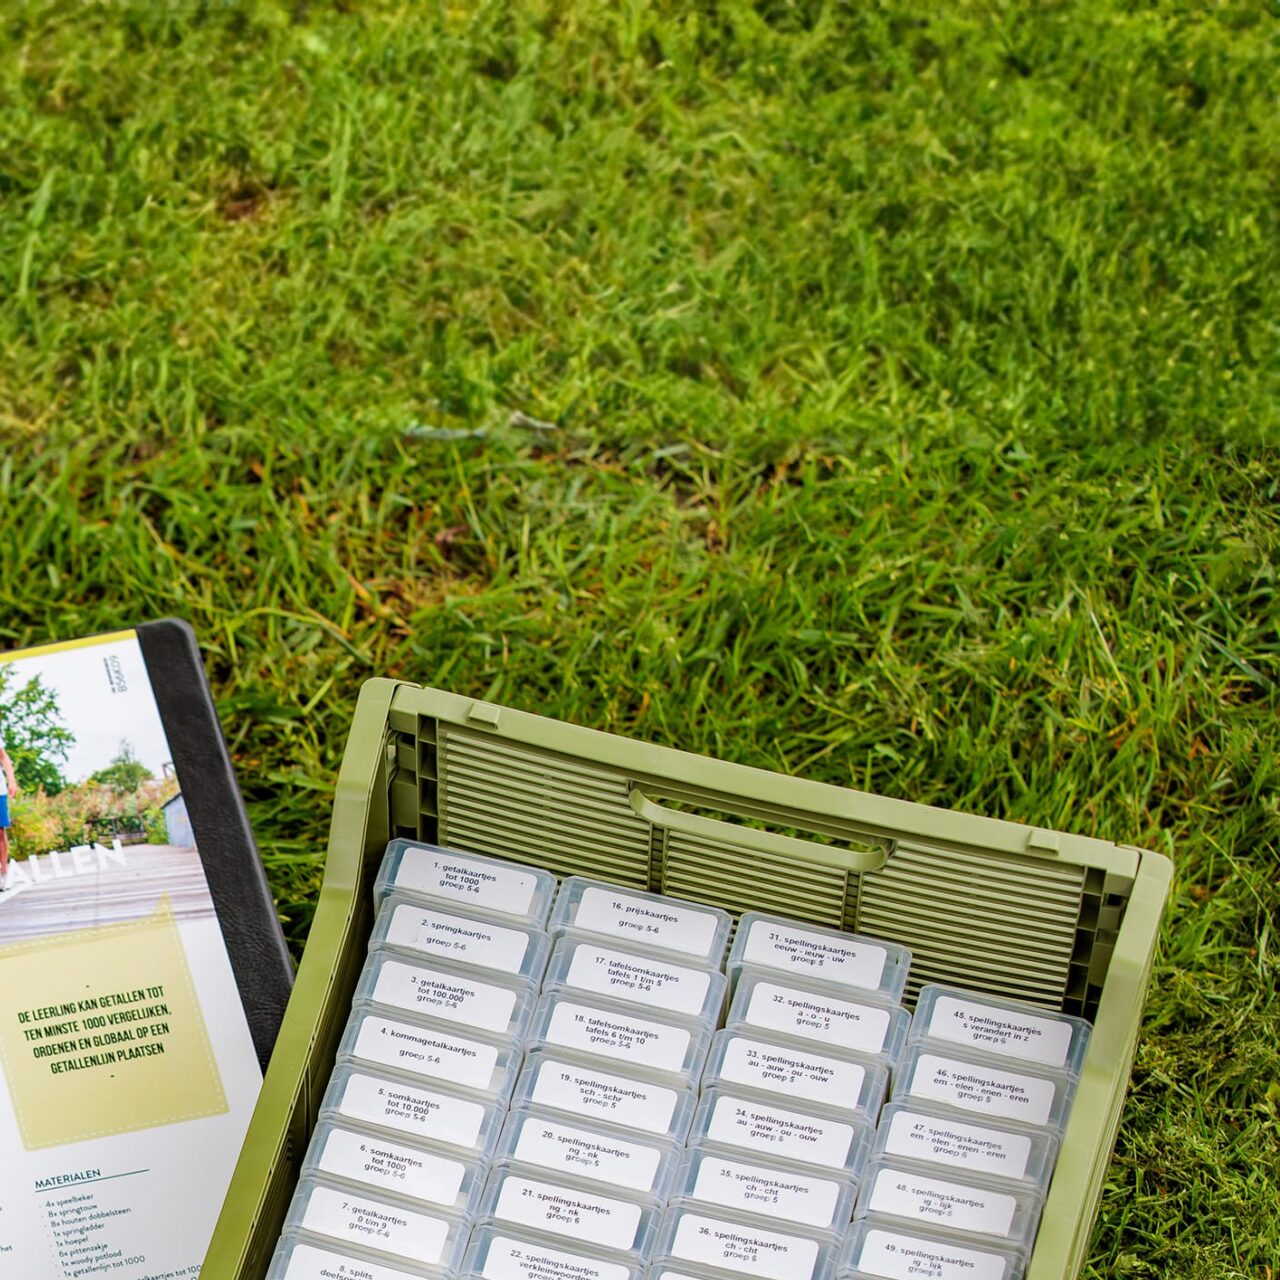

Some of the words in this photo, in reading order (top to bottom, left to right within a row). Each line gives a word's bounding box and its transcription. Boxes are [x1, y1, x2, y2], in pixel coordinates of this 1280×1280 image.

[442, 864, 496, 881] getalkaartjes
[445, 870, 458, 881] tot
[459, 875, 479, 885] 1000
[438, 879, 464, 890] groep
[466, 884, 479, 893] 5-6
[612, 901, 623, 910] 16.
[625, 906, 678, 922] prijskaartjes
[430, 922, 491, 941] springkaartjes
[425, 936, 451, 948] groep
[452, 941, 466, 950] 5-6
[768, 932, 781, 941] 31.
[783, 937, 856, 957] spellingskaartjes
[595, 956, 608, 965] 17.
[608, 960, 679, 982] tafelsomkaartjes
[419, 979, 474, 997] getalkaartjes
[17, 1010, 31, 1023] DE
[31, 1001, 77, 1021] LEERLING
[76, 998, 98, 1012] KAN
[98, 988, 145, 1008] GETALLEN
[146, 985, 163, 998] TOT
[771, 994, 785, 1004] 32.
[787, 999, 860, 1020] spellingskaartjes
[23, 1027, 43, 1041] TEN
[43, 1020, 80, 1037] MINSTE
[81, 1015, 106, 1030] 1000
[106, 1003, 171, 1025] VERGELIJKEN,
[953, 1010, 967, 1021] 45.
[968, 1015, 1041, 1035] spellingskaartjes
[32, 1039, 77, 1058] ORDENEN
[77, 1037, 92, 1050] EN
[92, 1028, 136, 1047] GLOBAAL
[135, 1025, 148, 1039] OP
[149, 1022, 169, 1036] EEN
[389, 1029, 476, 1057] kommagetalkaartjes
[50, 1051, 116, 1074] GETALLENLIJN
[116, 1042, 164, 1061] PLAATSEN
[386, 1099, 399, 1109] tot
[401, 1102, 429, 1115] 10.000
[387, 1091, 440, 1110] somkaartjes
[35, 1169, 102, 1189] MATERIALEN
[55, 1193, 93, 1207] speelbeker
[58, 1204, 97, 1218] springtouw
[60, 1213, 87, 1226] houten
[87, 1207, 131, 1221] dobbelsteen
[61, 1222, 104, 1237] springladder
[63, 1234, 88, 1246] hoepel
[68, 1242, 108, 1257] pittenzakje
[69, 1255, 93, 1265] woody
[94, 1248, 122, 1263] potlood
[72, 1261, 112, 1277] getallenlijn
[111, 1260, 124, 1268] tot
[123, 1254, 145, 1265] 1000
[509, 1249, 523, 1258] 22.
[525, 1254, 599, 1277] spellingskaartjes
[174, 1268, 186, 1276] tot
[349, 1269, 373, 1280] splits
